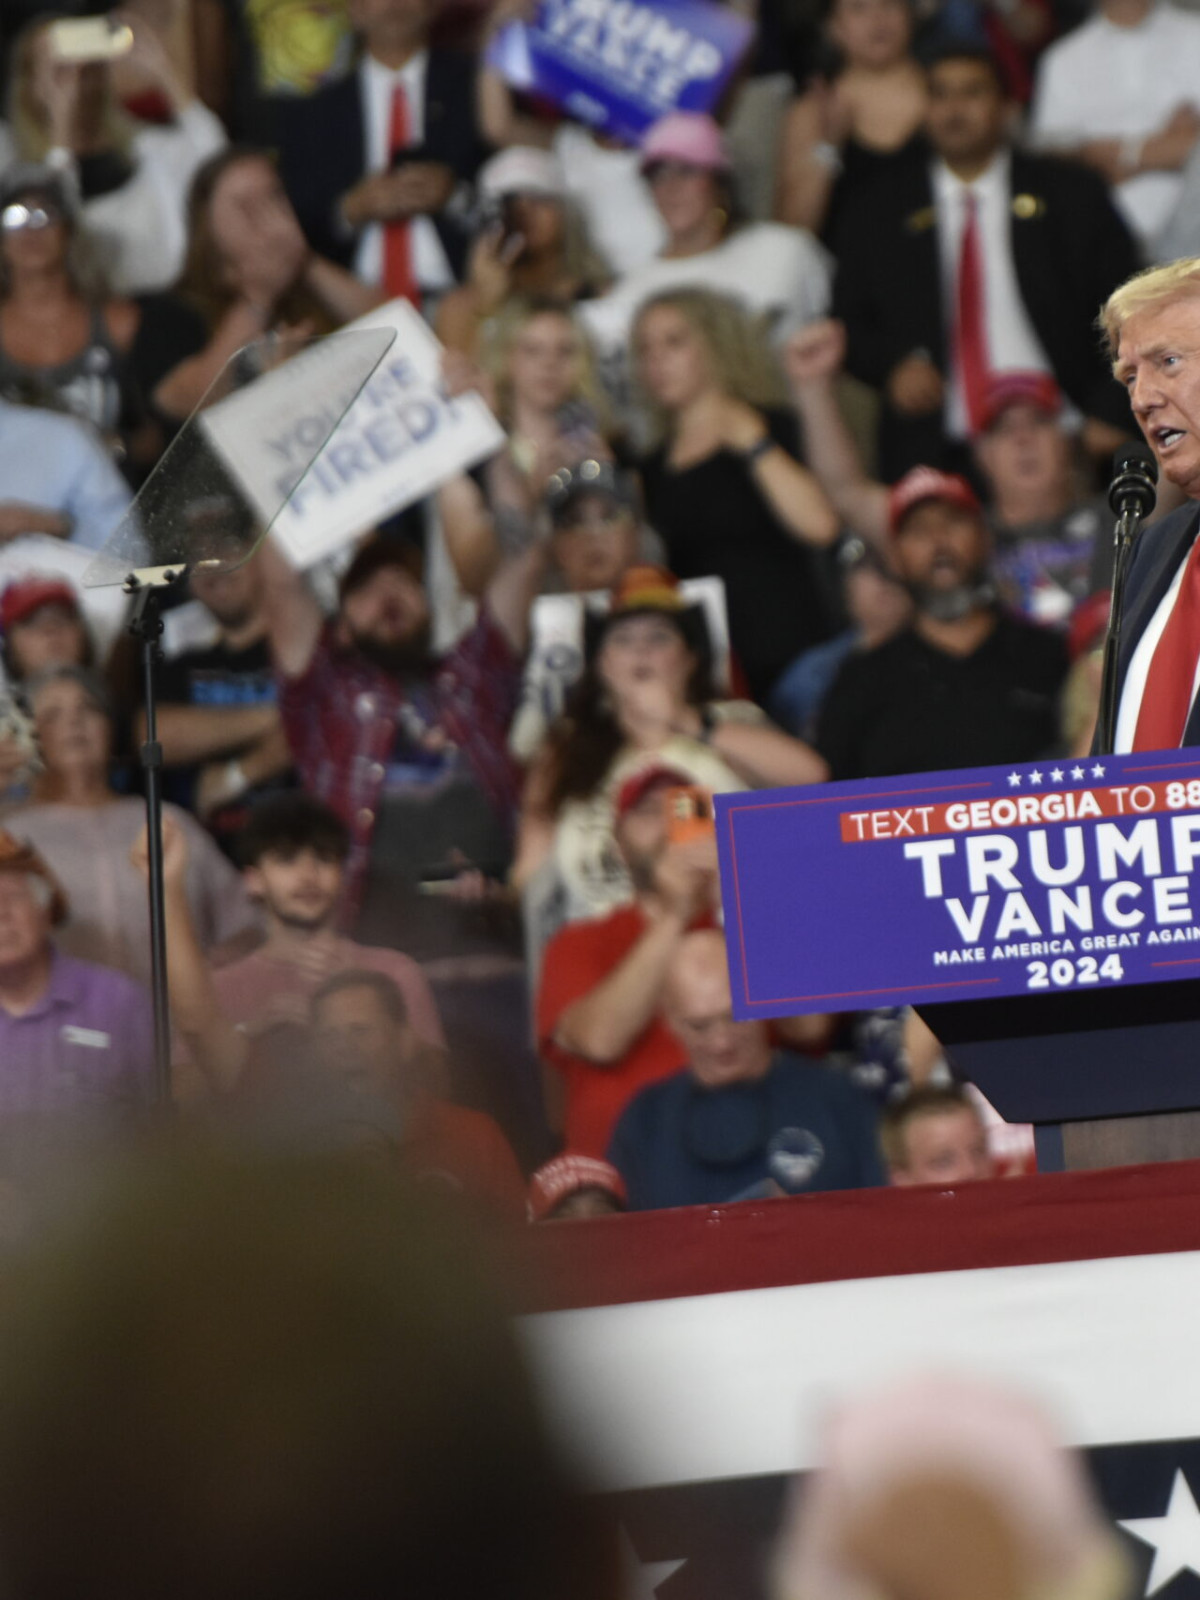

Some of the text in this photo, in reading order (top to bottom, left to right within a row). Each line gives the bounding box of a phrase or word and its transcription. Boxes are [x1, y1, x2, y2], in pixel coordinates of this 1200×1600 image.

[263, 354, 412, 460] YOU'RE
[850, 807, 935, 840] TEXT
[944, 791, 1103, 830] GEORGIA
[1110, 785, 1156, 814] TO
[945, 875, 1193, 943] VANCE
[933, 948, 986, 966] MAKE
[991, 938, 1075, 960] AMERICA
[1080, 932, 1141, 952] GREAT
[1026, 954, 1124, 988] 2024
